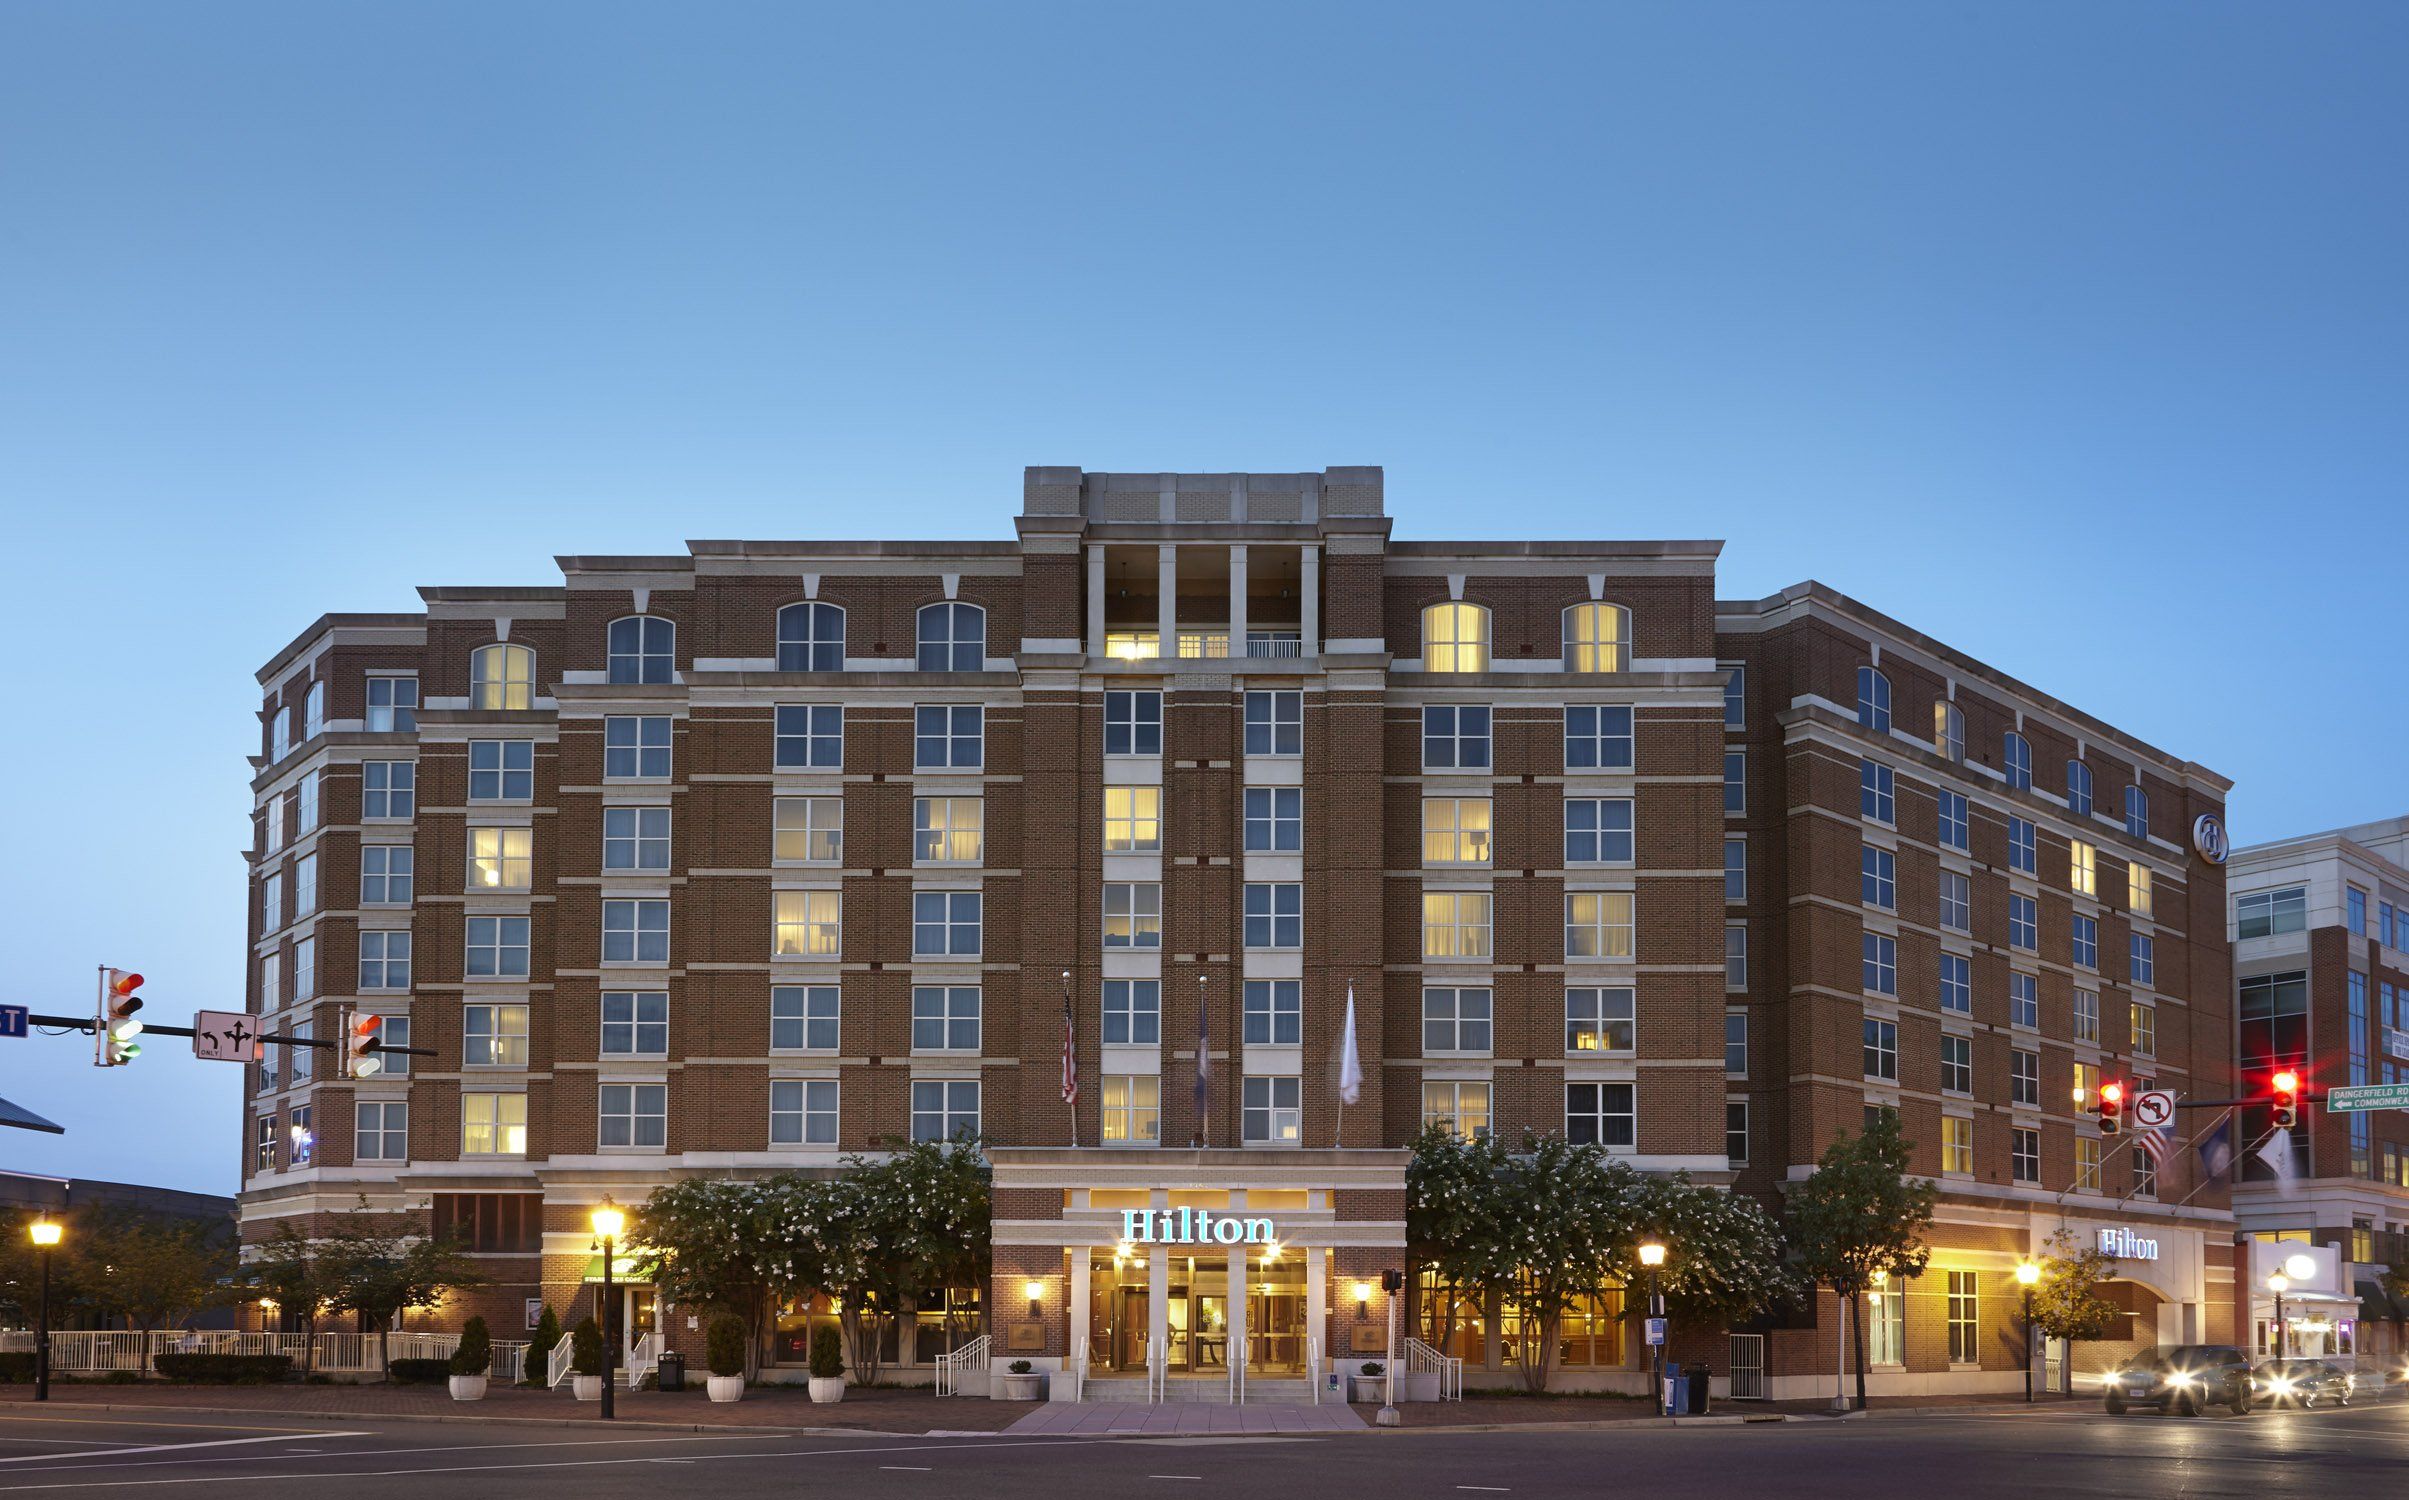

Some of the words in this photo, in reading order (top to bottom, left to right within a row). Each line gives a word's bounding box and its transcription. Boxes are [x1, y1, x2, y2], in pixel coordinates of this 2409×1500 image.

[0, 1009, 20, 1033] T
[200, 1049, 219, 1057] ONLY
[2334, 1088, 2393, 1099] DAINGERFIELD
[2396, 1087, 2408, 1096] RD
[1120, 1206, 1277, 1244] Hilton
[2098, 1227, 2159, 1260] Hilton
